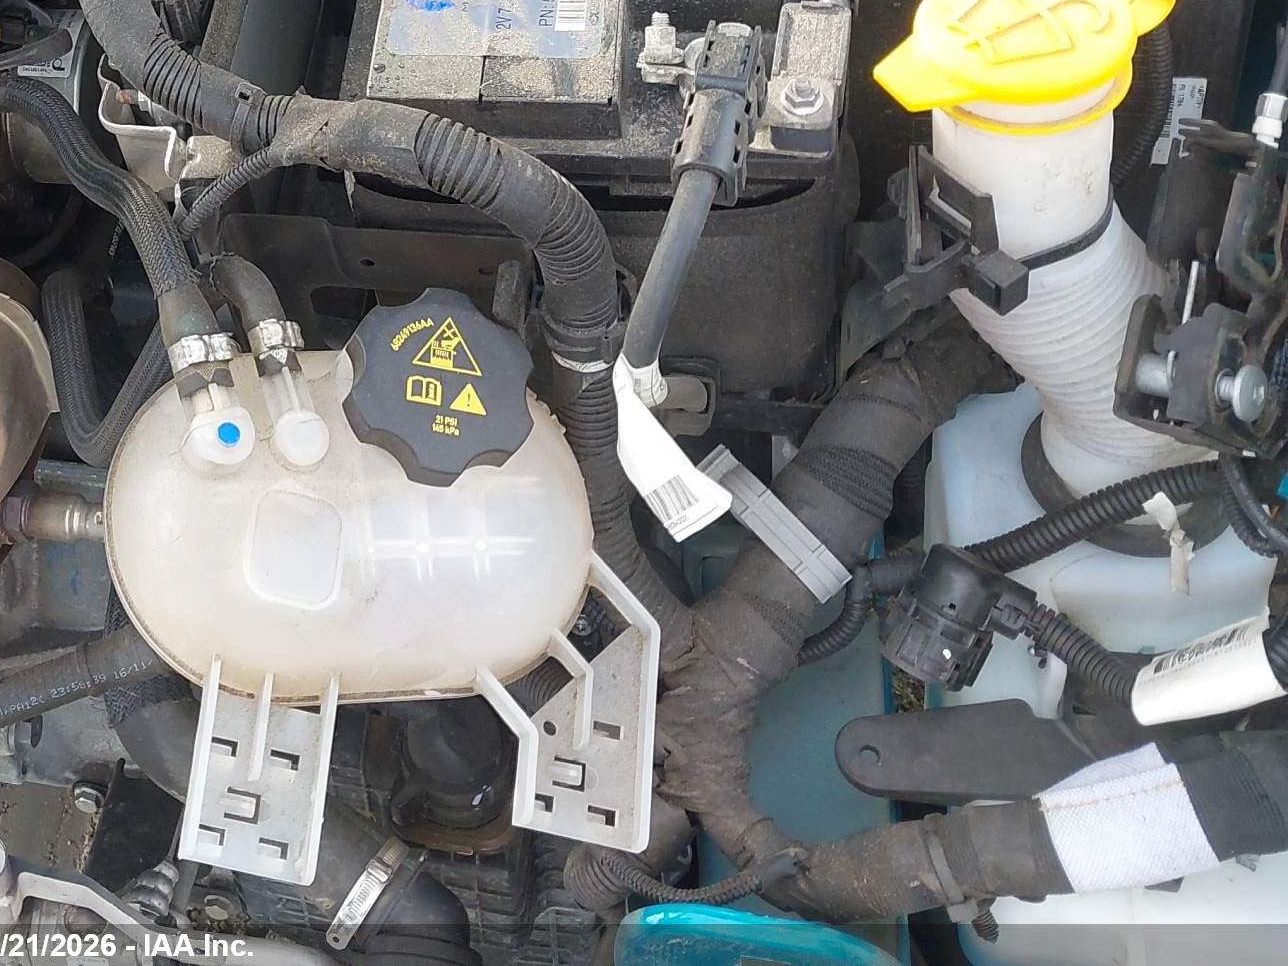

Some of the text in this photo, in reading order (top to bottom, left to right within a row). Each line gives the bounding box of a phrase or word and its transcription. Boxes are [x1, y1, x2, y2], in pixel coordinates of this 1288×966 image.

[538, 6, 556, 27] PN:
[390, 316, 434, 352] 68249136AA
[435, 414, 458, 427] 21 PSI
